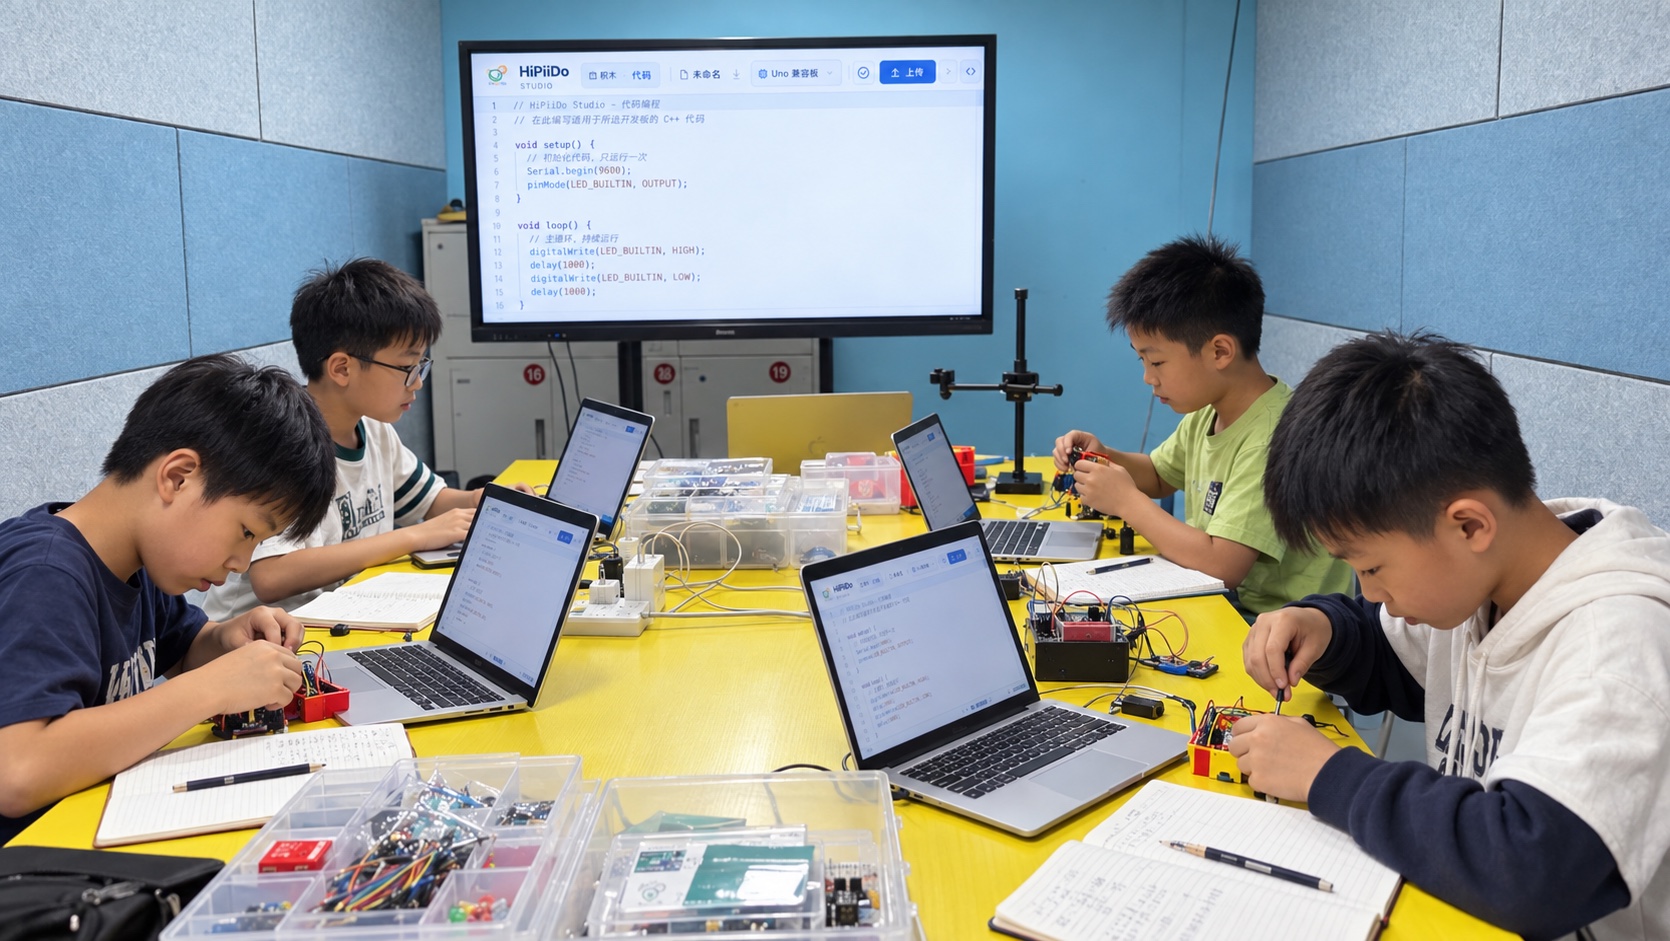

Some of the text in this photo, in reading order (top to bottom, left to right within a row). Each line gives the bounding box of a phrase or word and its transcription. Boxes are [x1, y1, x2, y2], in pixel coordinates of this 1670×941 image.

[519, 65, 569, 78] HiPiiDo
[631, 70, 651, 80] 代码
[771, 69, 789, 78] Uno
[906, 67, 924, 77] 上传
[520, 82, 553, 90] STUDIO
[492, 102, 496, 110] 1
[530, 101, 567, 110] HiPiiDo
[572, 101, 605, 109] Studio
[492, 116, 497, 124] 2
[663, 115, 680, 124] C++
[685, 114, 705, 124] 代码
[493, 128, 498, 137] 3
[493, 141, 498, 149] 4
[515, 141, 538, 150] void
[544, 140, 582, 151] setup()
[493, 155, 499, 163] 5
[493, 166, 631, 177] 6 Serial.begin(9600);
[494, 179, 688, 191] 7 pinMode(LED_BUILTIN, OUTPUT);
[494, 194, 500, 203] 8
[495, 208, 500, 217] 9
[492, 222, 501, 230] 10
[517, 221, 540, 230] void
[546, 220, 578, 231] loop()
[493, 235, 501, 244] 11
[494, 246, 705, 257] 12 digitalWrite(LED_BUILTIN, HIGH);
[494, 260, 595, 270] 13 delay(1000);
[494, 272, 701, 283] 14 digitalWrite(LED_BUILTIN, LOW);
[495, 287, 596, 297] 15 delay(1000);
[526, 368, 542, 381] 16
[772, 366, 788, 379] 19
